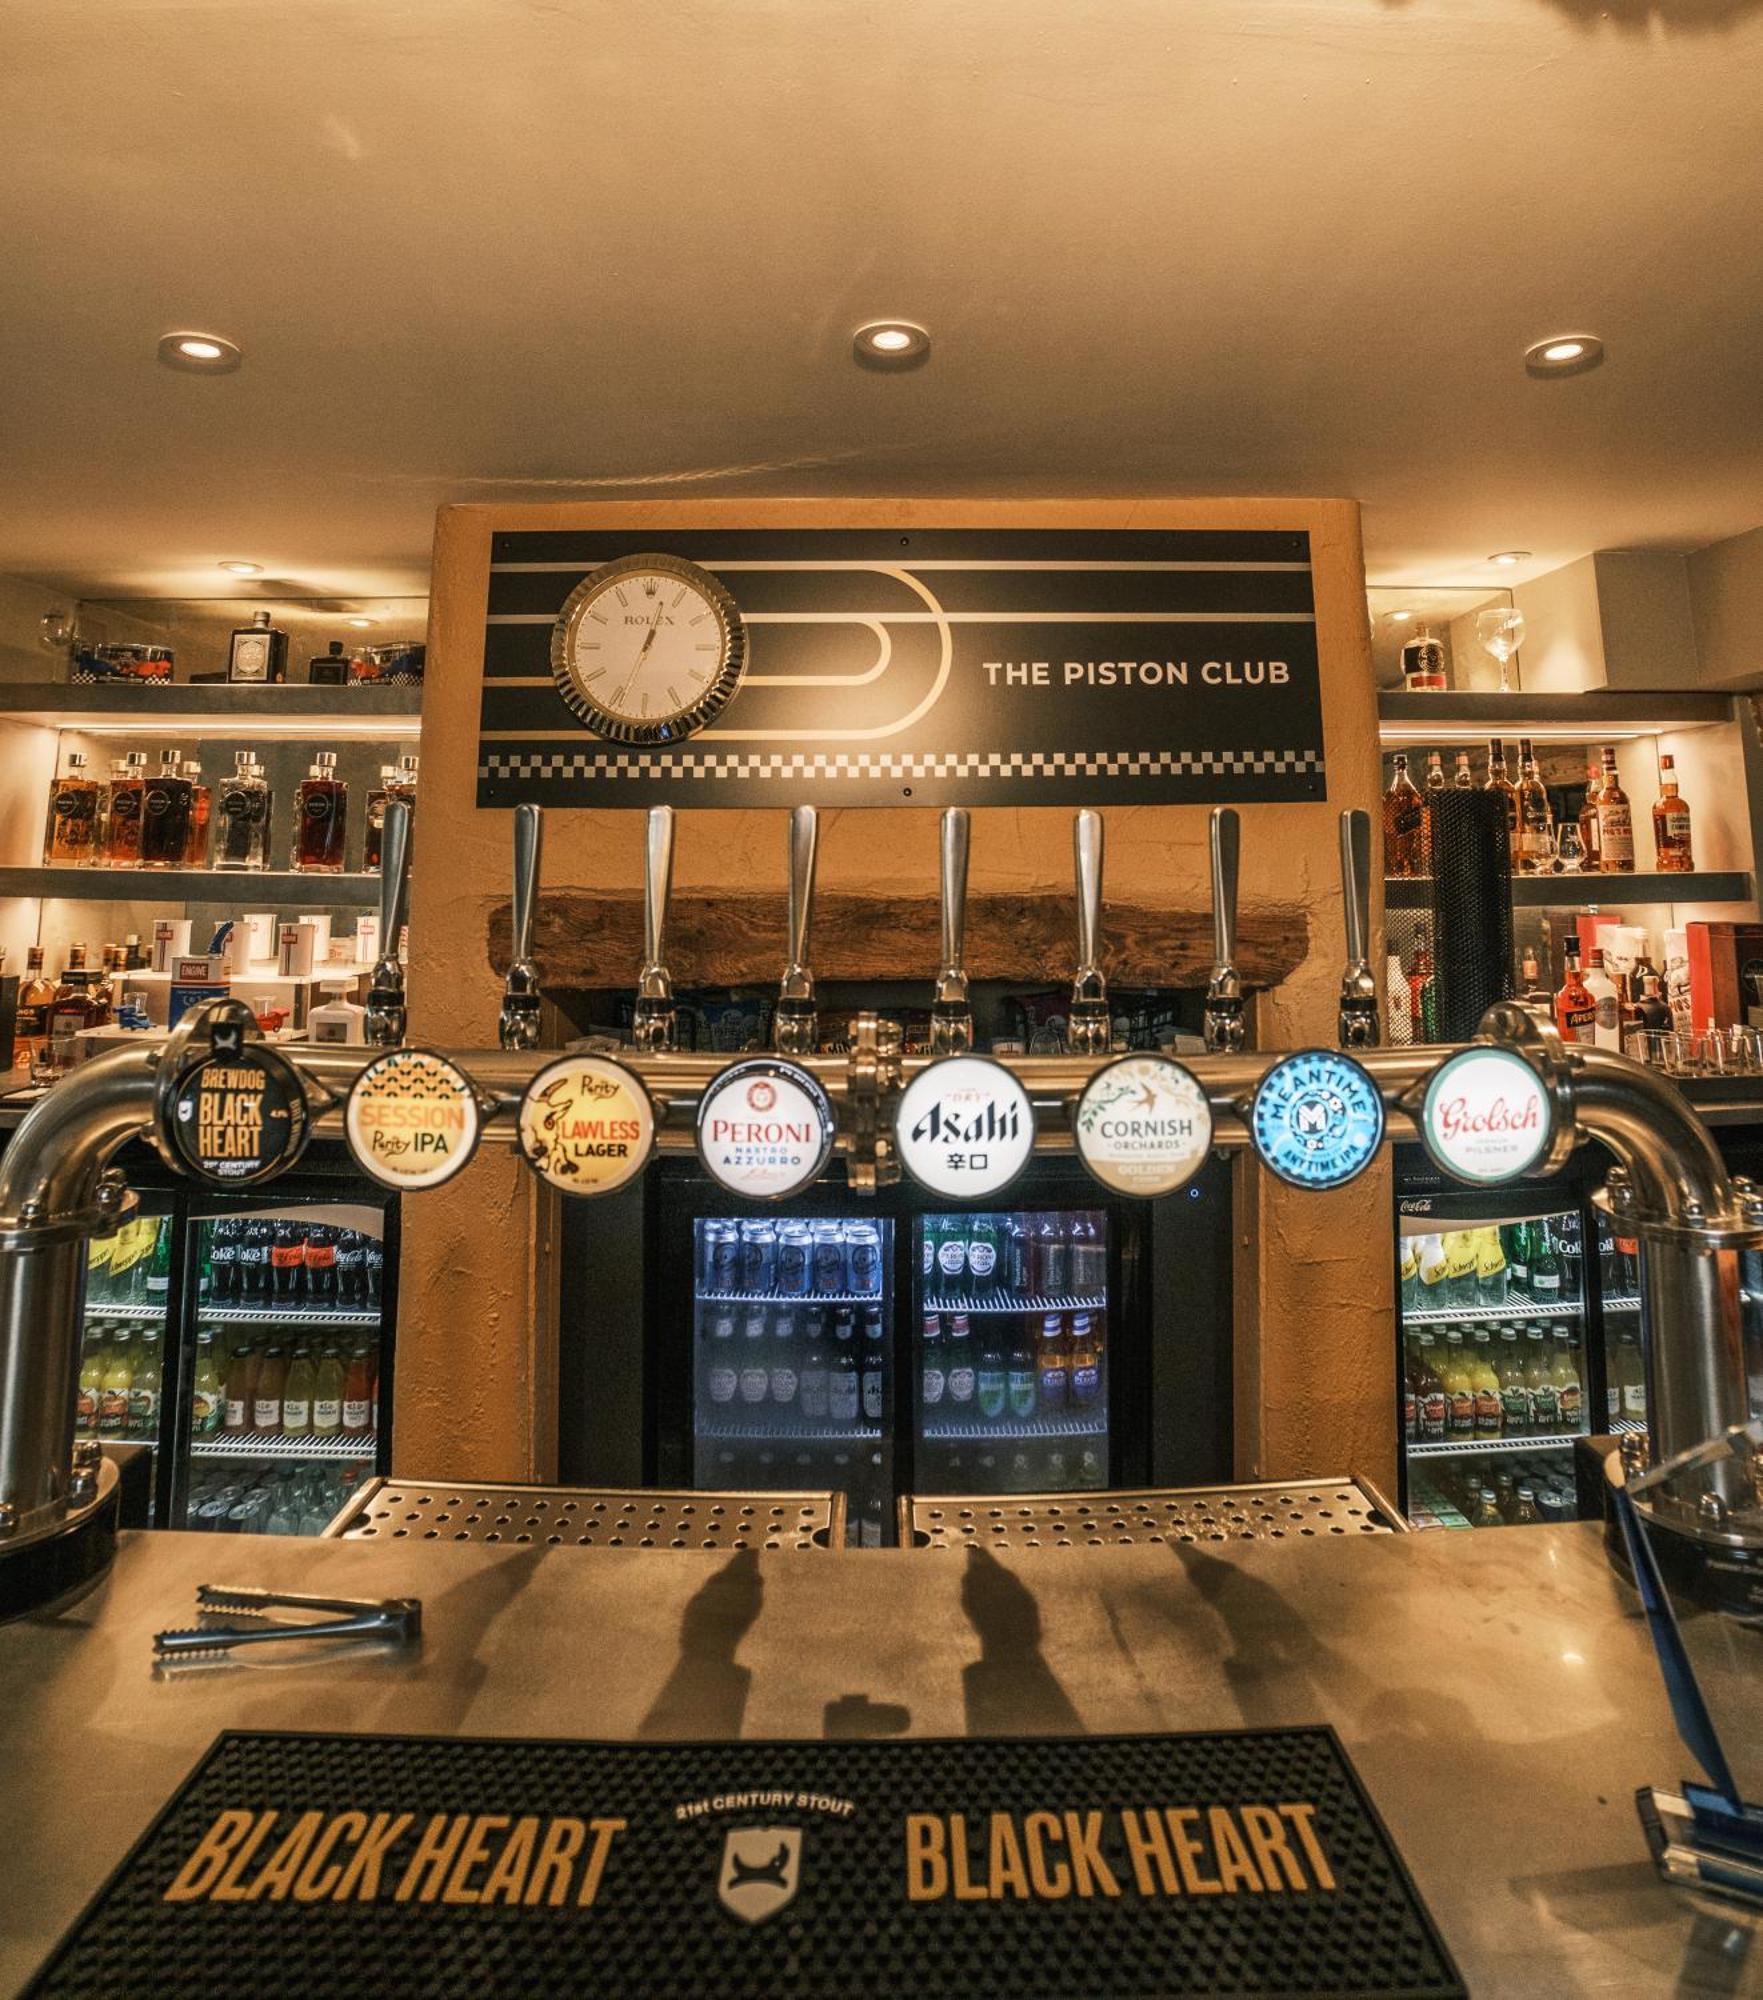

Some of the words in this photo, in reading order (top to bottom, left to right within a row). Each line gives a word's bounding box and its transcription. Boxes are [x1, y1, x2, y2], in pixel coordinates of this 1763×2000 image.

[624, 615, 675, 626] ROLEX
[982, 661, 1050, 686] THE
[1063, 661, 1188, 685] PISTON
[1201, 660, 1290, 685] CLUB
[180, 965, 208, 978] ENGINE
[201, 1068, 266, 1089] BREWDOG
[580, 1075, 621, 1102] Purity
[1271, 1069, 1367, 1120] MEANTIME
[199, 1092, 264, 1126] BLACK
[360, 1103, 466, 1131] SESSION
[1299, 1103, 1327, 1132] M
[1440, 1095, 1538, 1141] Grolsch
[561, 1120, 640, 1140] LAWLESS
[713, 1119, 811, 1143] PERONI
[911, 1099, 1019, 1144] Asahi
[1100, 1119, 1193, 1139] CORNISH
[199, 1125, 263, 1158] HEART
[372, 1130, 411, 1158] Purity
[414, 1132, 448, 1154] IPA
[574, 1143, 628, 1158] LAGER
[735, 1146, 788, 1154] NASTRO
[1113, 1140, 1180, 1151] ORCHARDS
[219, 1160, 261, 1169] CENTURY
[722, 1155, 801, 1166] AZZURRO
[946, 1152, 988, 1171] 辛口
[1284, 1150, 1339, 1172] ANYTIME
[1339, 1144, 1359, 1163] IPA
[217, 1168, 246, 1177] STOUT
[210, 1245, 236, 1262] oke
[240, 1247, 261, 1262] oke
[675, 1802, 709, 1820] 21st
[712, 1790, 794, 1811] CENTURY
[796, 1793, 855, 1817] STOUT
[162, 1809, 414, 1902] BLACK
[394, 1813, 628, 1907] HEART
[905, 1810, 1122, 1901] BLACK
[1121, 1804, 1337, 1897] HEART
